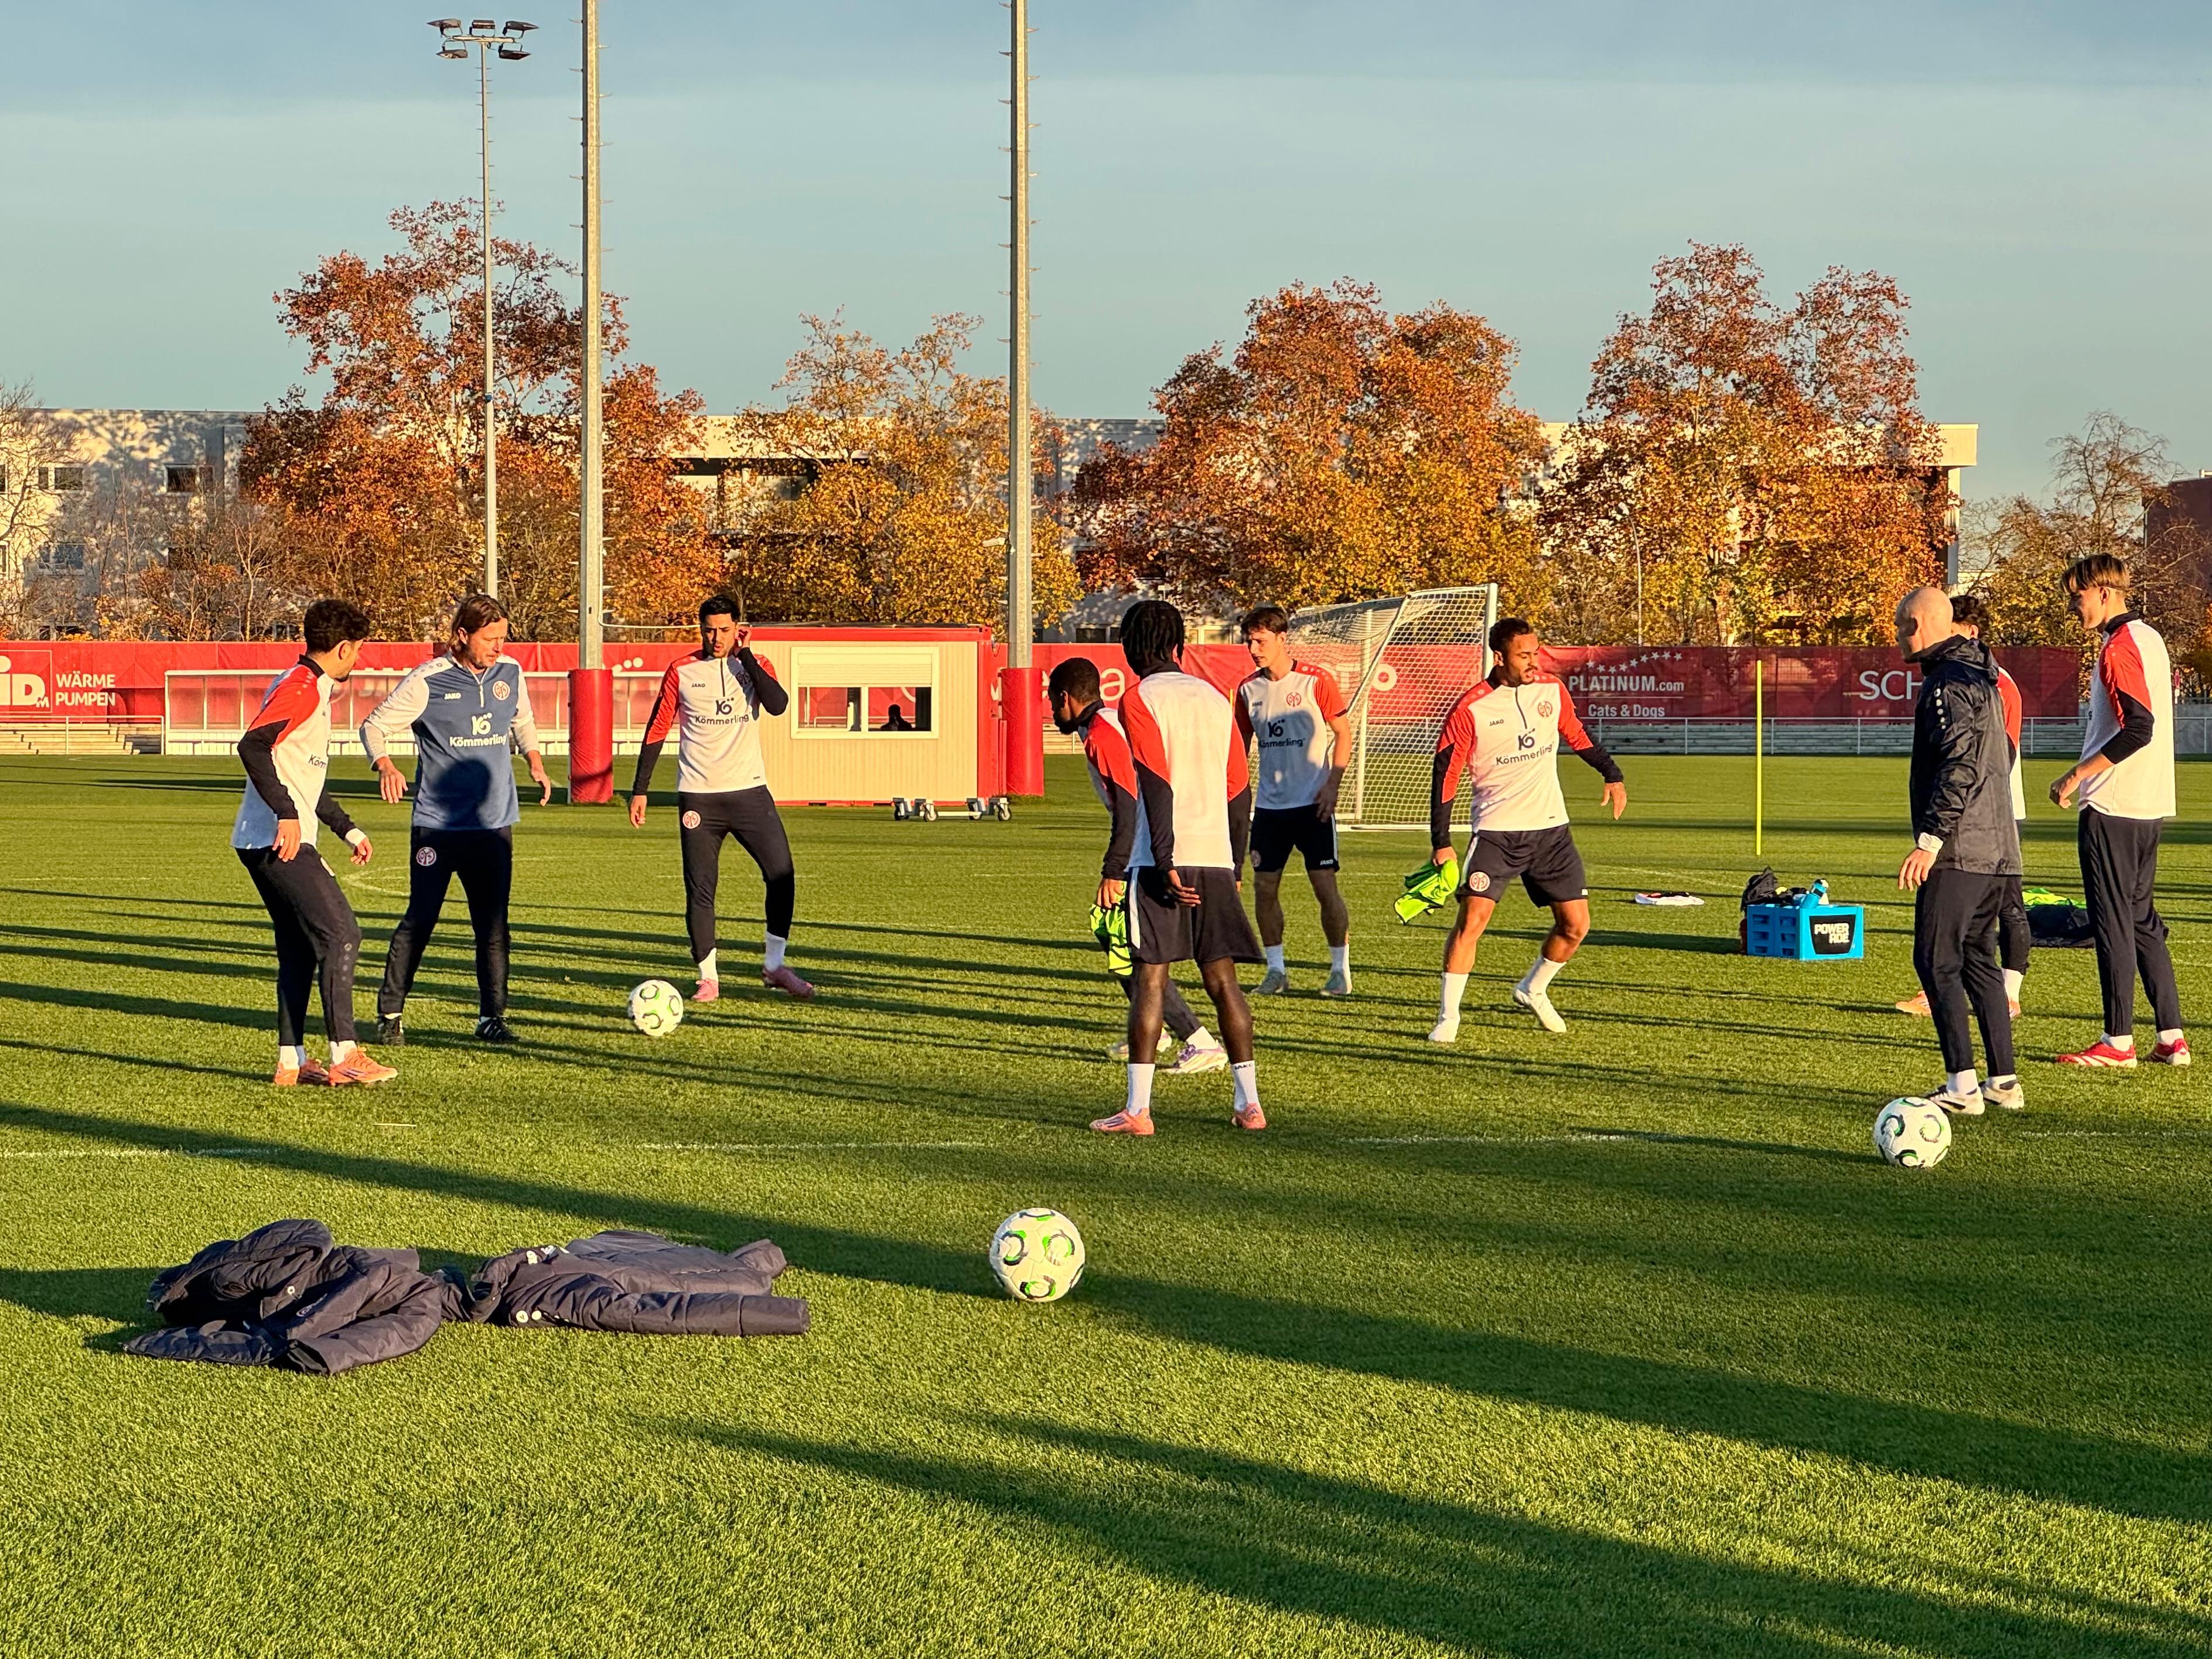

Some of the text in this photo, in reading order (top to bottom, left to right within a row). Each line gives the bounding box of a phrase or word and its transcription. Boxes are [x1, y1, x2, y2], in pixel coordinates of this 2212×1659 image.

[56, 671, 115, 688] WÄRME
[1568, 675, 1684, 692] PLATINUM.com
[56, 692, 115, 706] PUMPEN
[1588, 704, 1665, 718] Cats & Dogs
[695, 714, 749, 725] Kömmerling
[449, 733, 507, 747] Kömmerling
[1814, 923, 1849, 934] POWER
